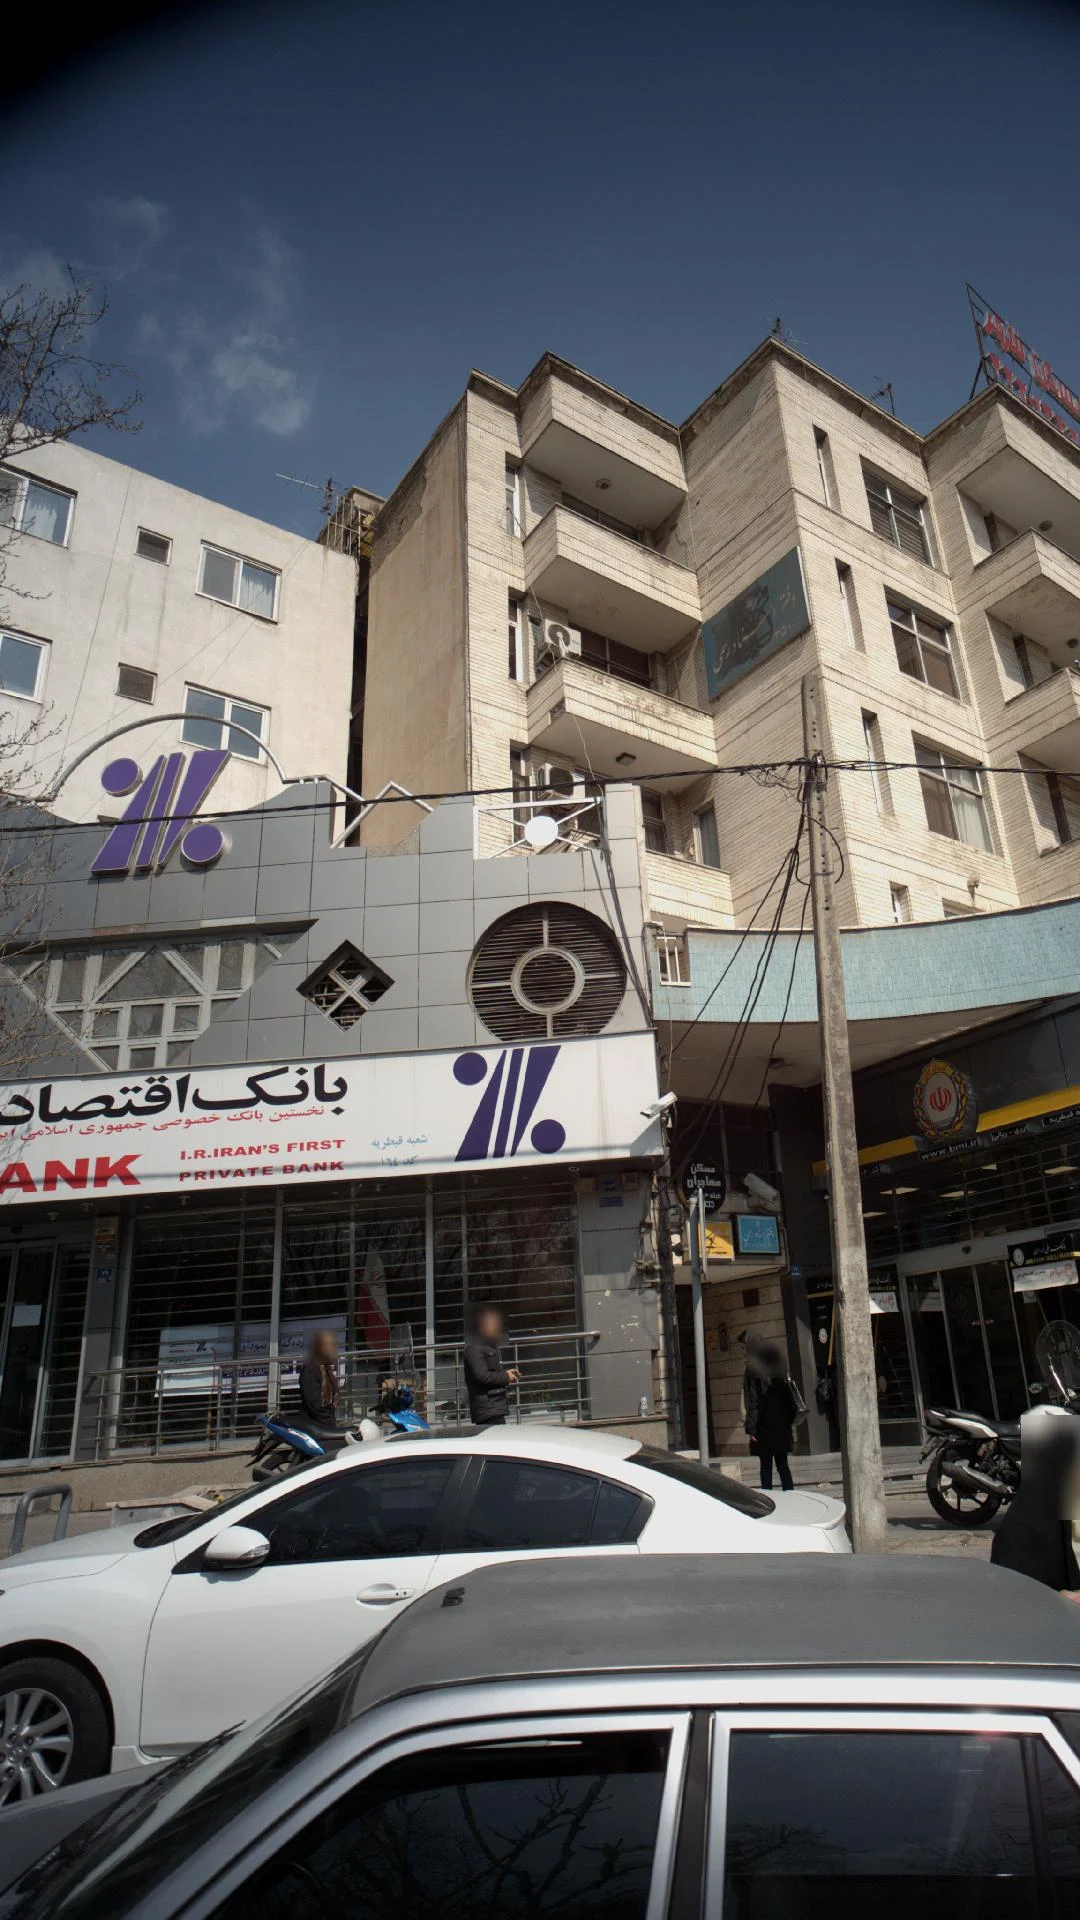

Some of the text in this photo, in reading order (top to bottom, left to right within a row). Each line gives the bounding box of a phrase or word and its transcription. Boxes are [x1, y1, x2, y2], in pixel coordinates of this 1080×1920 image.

[0, 1063, 348, 1126] بانک اقتصاد
[153, 1114, 221, 1131] خصوصی
[226, 1110, 263, 1123] بانک
[268, 1105, 325, 1123] نخستین
[20, 1124, 73, 1141] اسلامی
[79, 1120, 147, 1135] جمهوری
[180, 1139, 345, 1160] I.R.IRAN'S FIRST
[920, 1138, 979, 1160] www.bmi.ir
[179, 1161, 344, 1182] PRIVATE BANK
